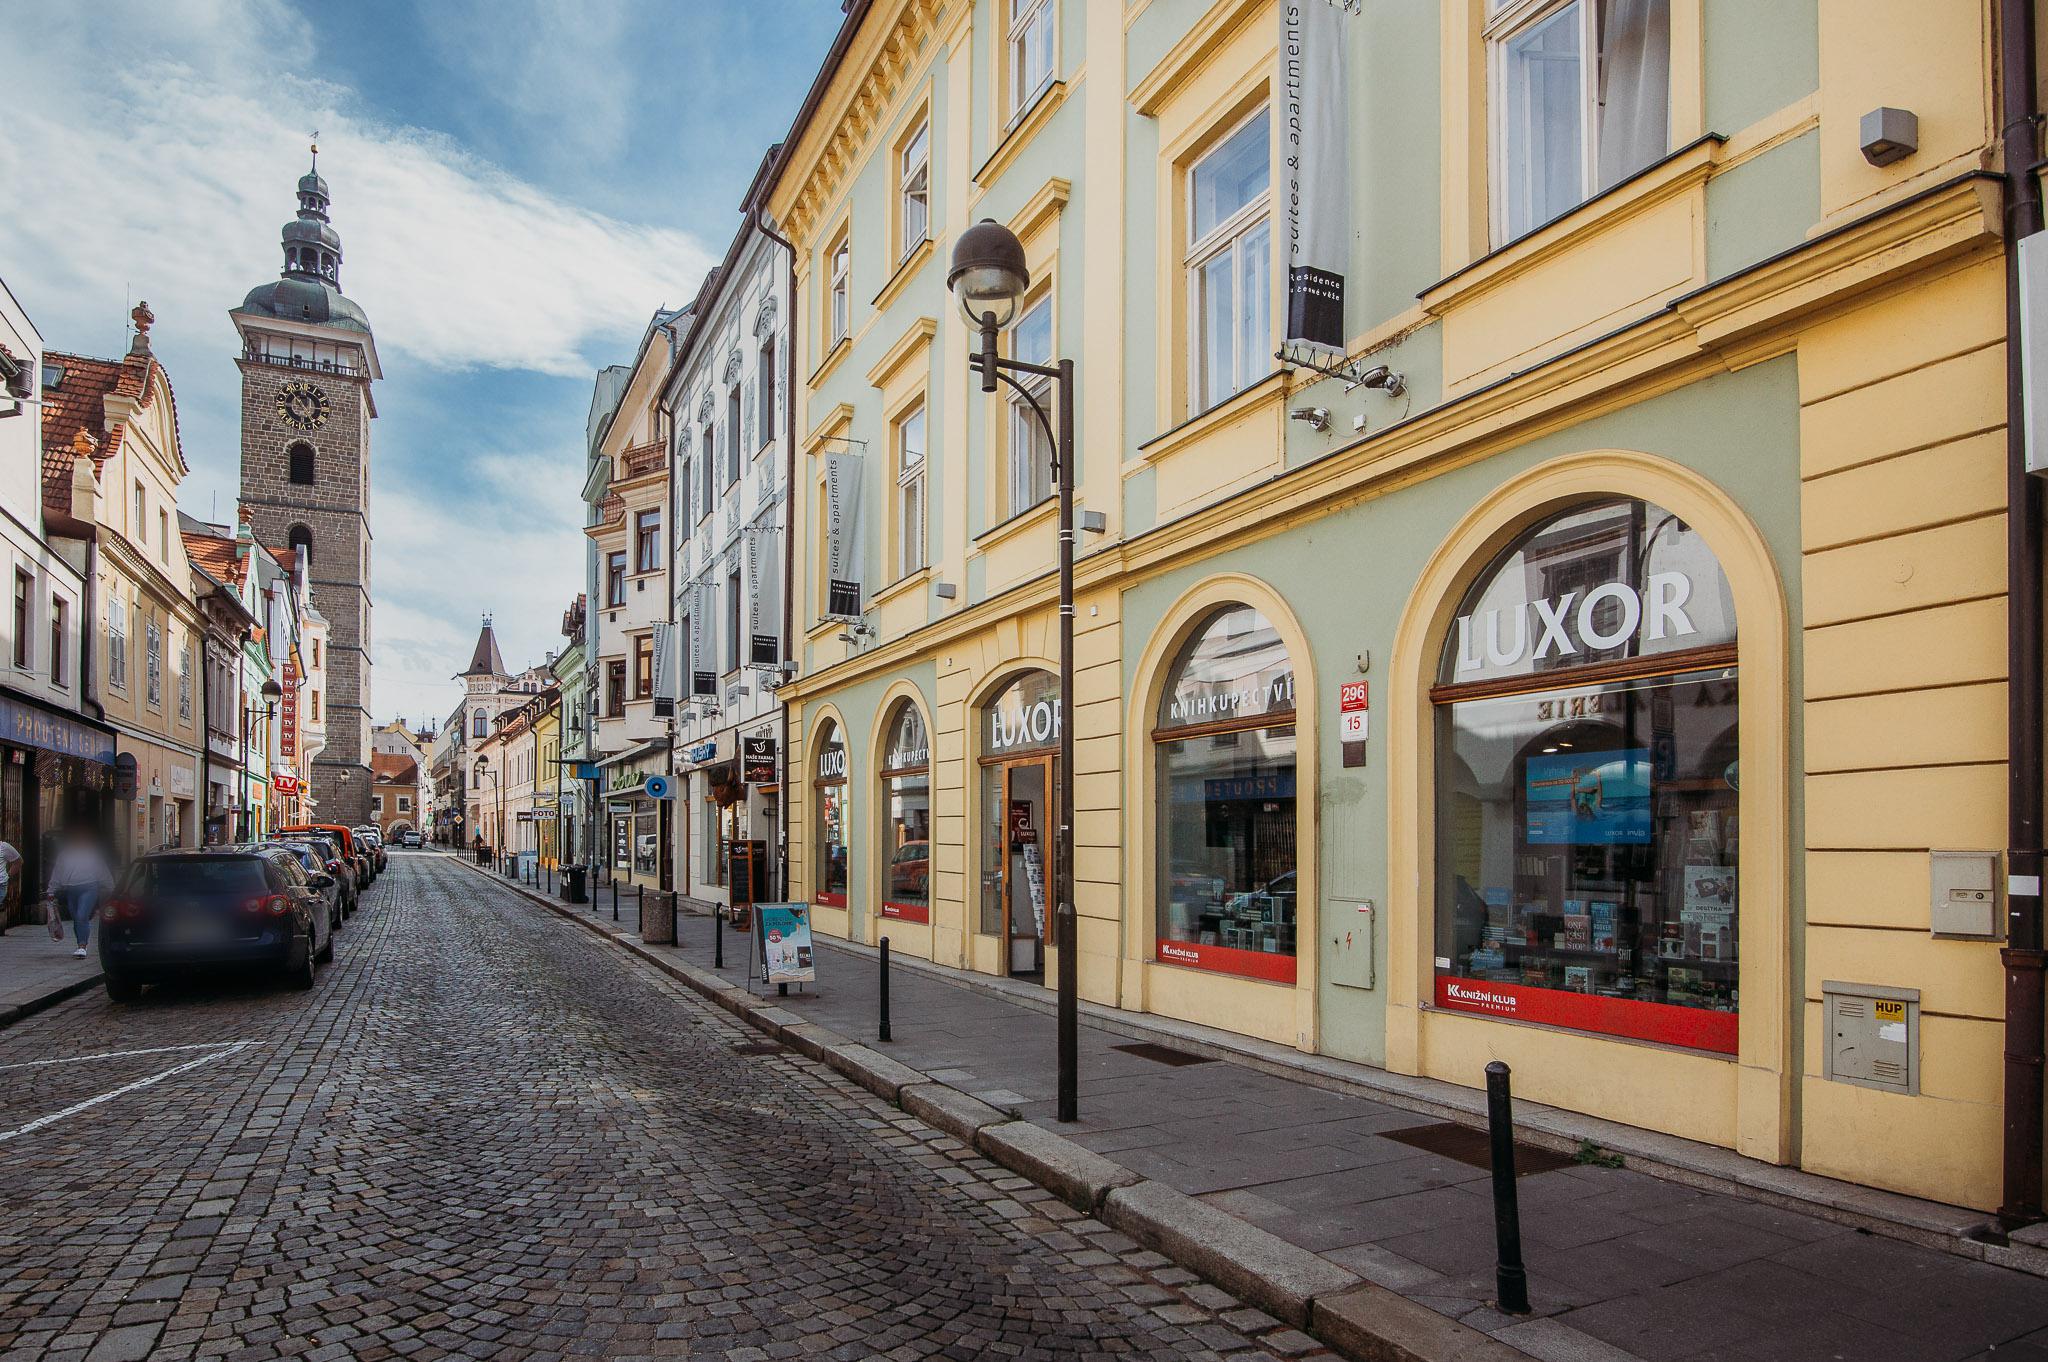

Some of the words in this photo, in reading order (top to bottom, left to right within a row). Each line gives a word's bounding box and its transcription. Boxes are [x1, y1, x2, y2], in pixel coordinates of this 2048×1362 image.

[1286, 4, 1303, 147] apartments
[1287, 155, 1300, 171] &
[1288, 179, 1300, 254] suites
[830, 459, 841, 524] apartments
[832, 526, 840, 536] &
[749, 536, 759, 590] apartments
[832, 539, 840, 574] suites
[1457, 570, 1698, 672] LUXOR
[1170, 677, 1294, 719] KNIHKUPECTVÍ
[1343, 684, 1365, 702] 296
[1347, 716, 1361, 730] 15
[277, 777, 296, 788] TV
[1567, 920, 1583, 930] ONE
[1461, 990, 1490, 1002] KNIŽNÍ
[1492, 994, 1517, 1005] KLUB
[1481, 1003, 1516, 1012] PREMIUM
[1875, 1002, 1902, 1013] HUP
